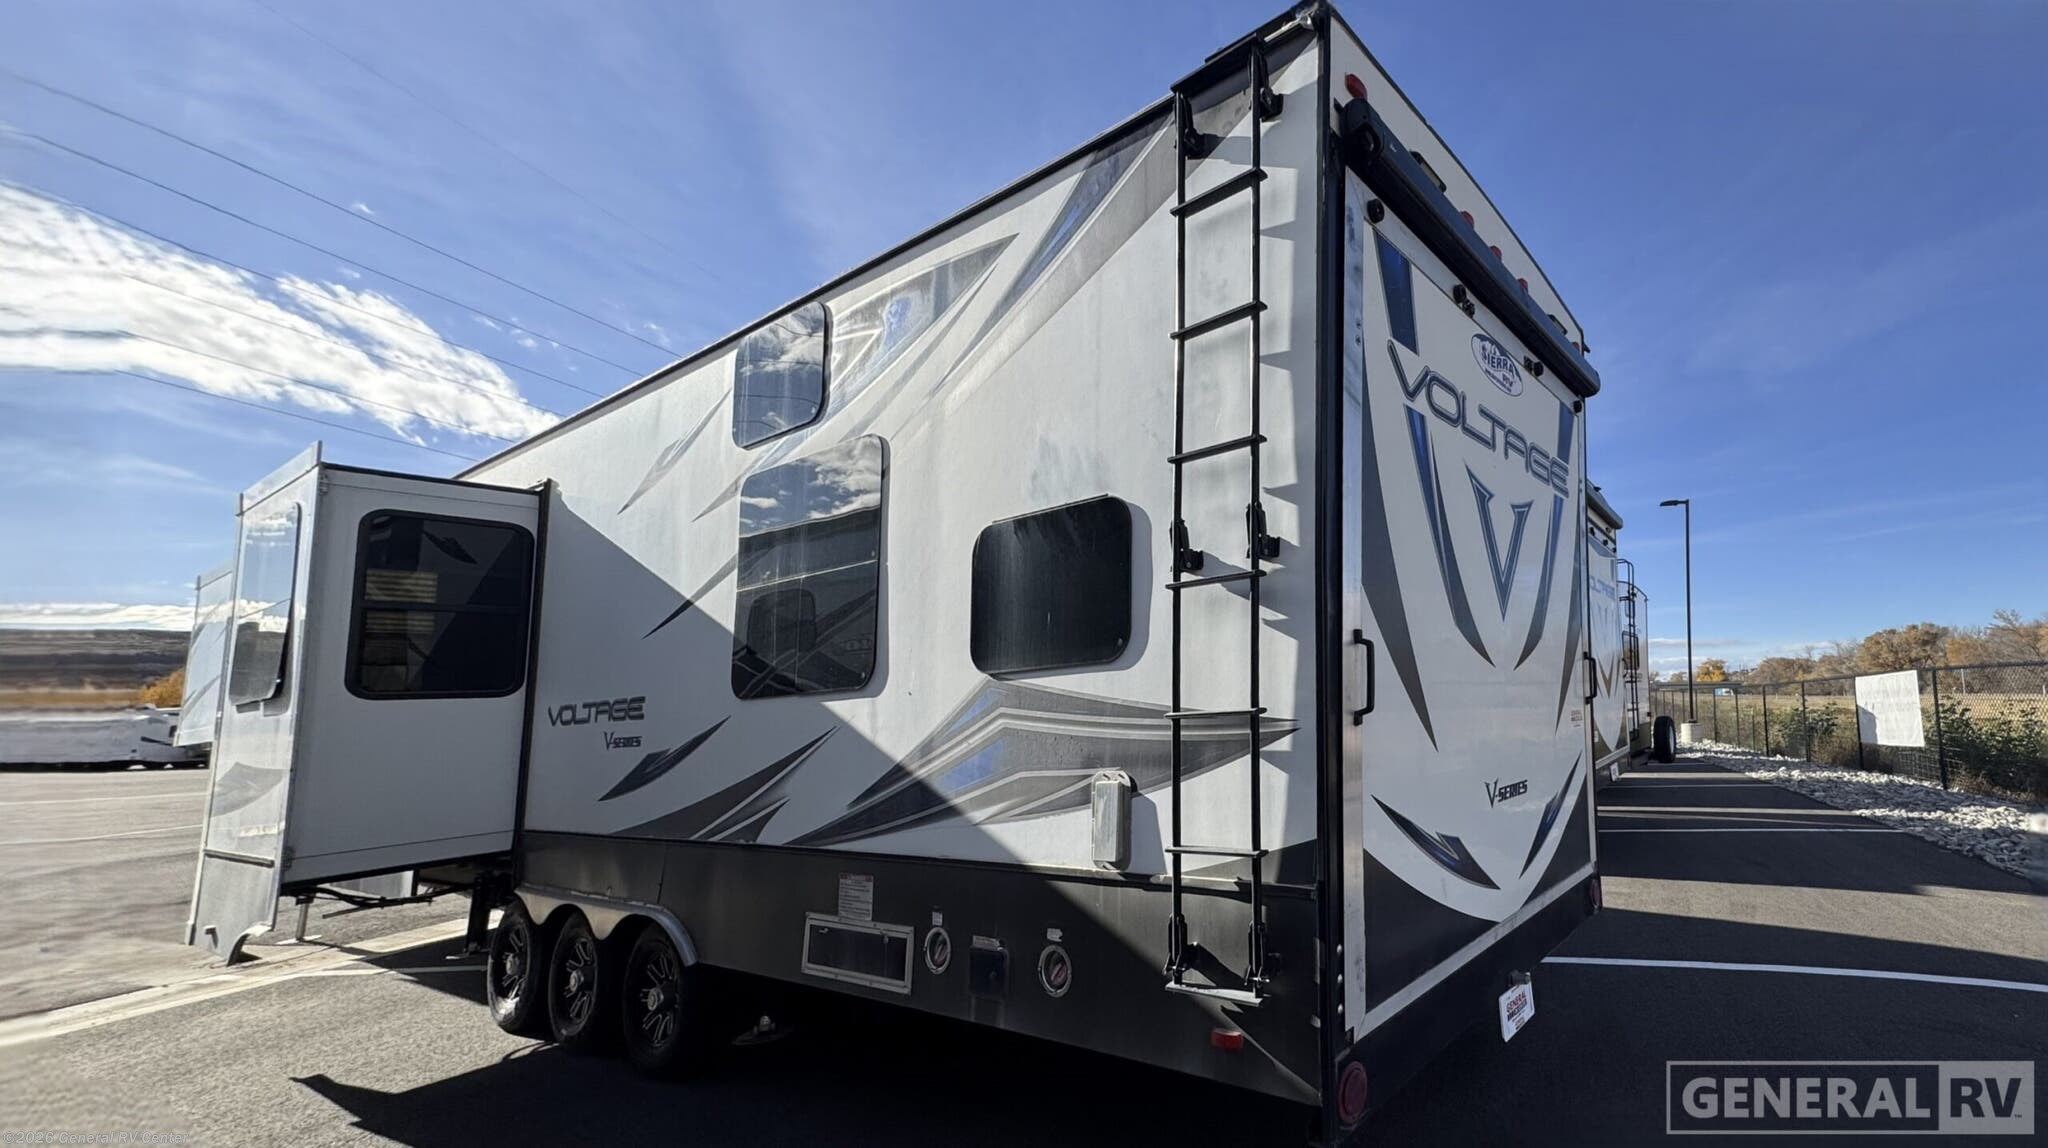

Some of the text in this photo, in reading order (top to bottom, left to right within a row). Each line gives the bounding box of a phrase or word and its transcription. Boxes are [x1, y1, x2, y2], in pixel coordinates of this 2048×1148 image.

[1481, 350, 1515, 380] SIERRA
[1387, 338, 1569, 499] VOLTAGE
[548, 696, 646, 726] VOLTAGE
